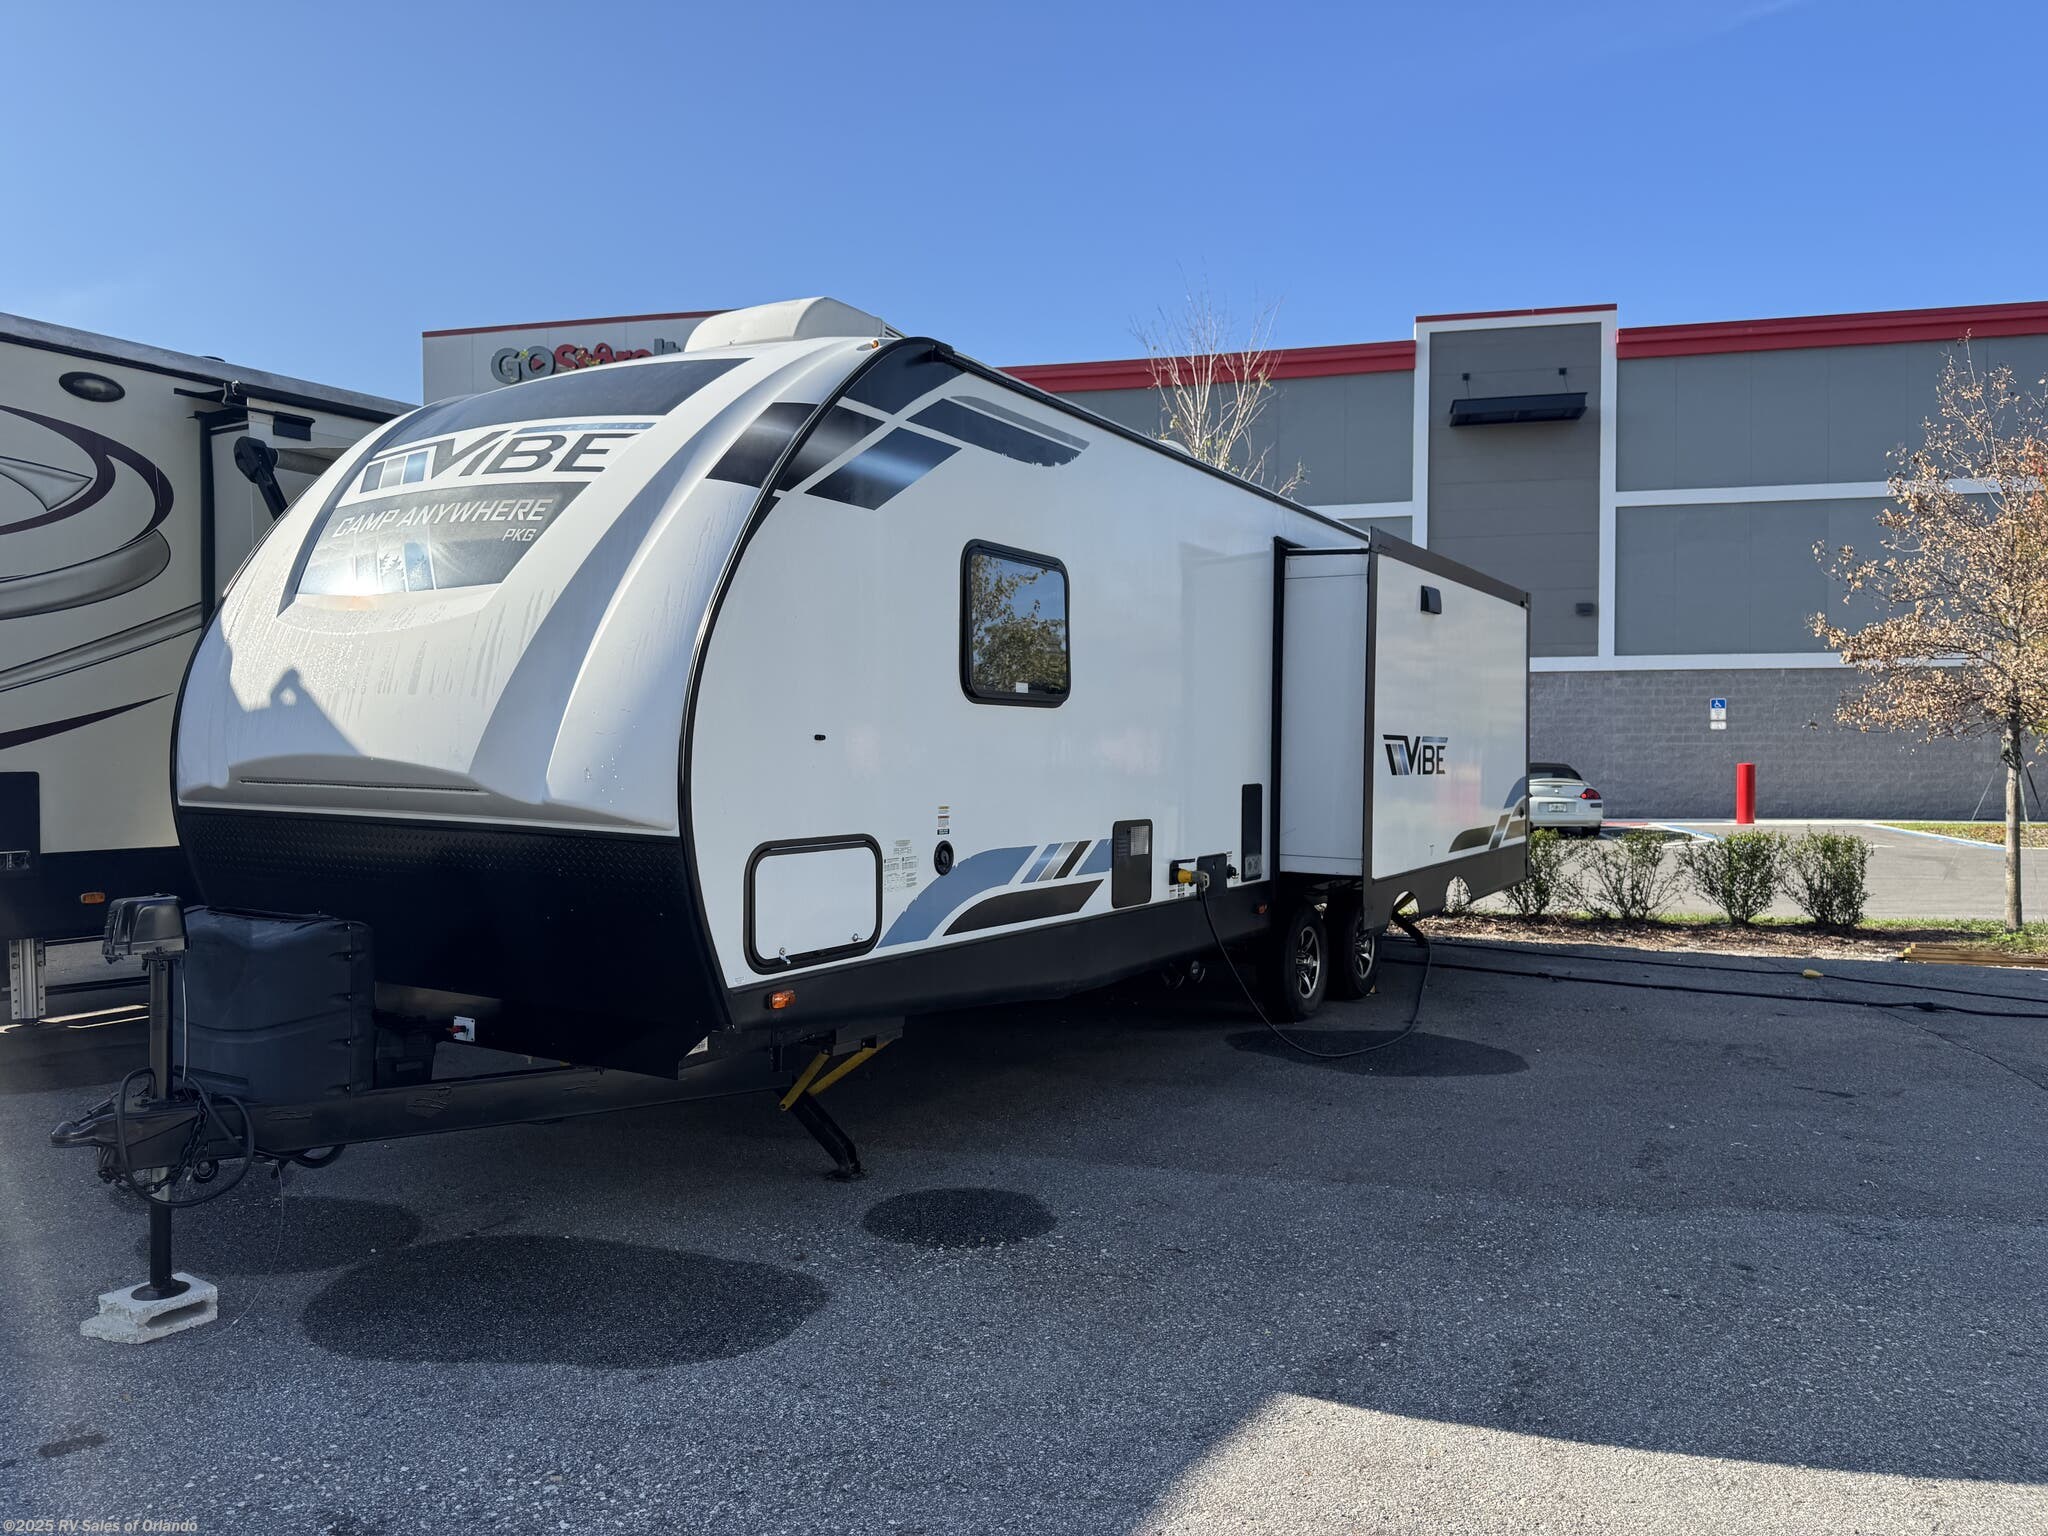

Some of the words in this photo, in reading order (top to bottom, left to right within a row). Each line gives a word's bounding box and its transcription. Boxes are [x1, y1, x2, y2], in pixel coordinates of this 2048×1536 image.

[373, 429, 641, 480] VIBE
[332, 508, 399, 538] CAMP
[399, 498, 553, 527] ANYWHERE
[502, 528, 537, 542] PKG
[1383, 734, 1446, 775] VIBE
